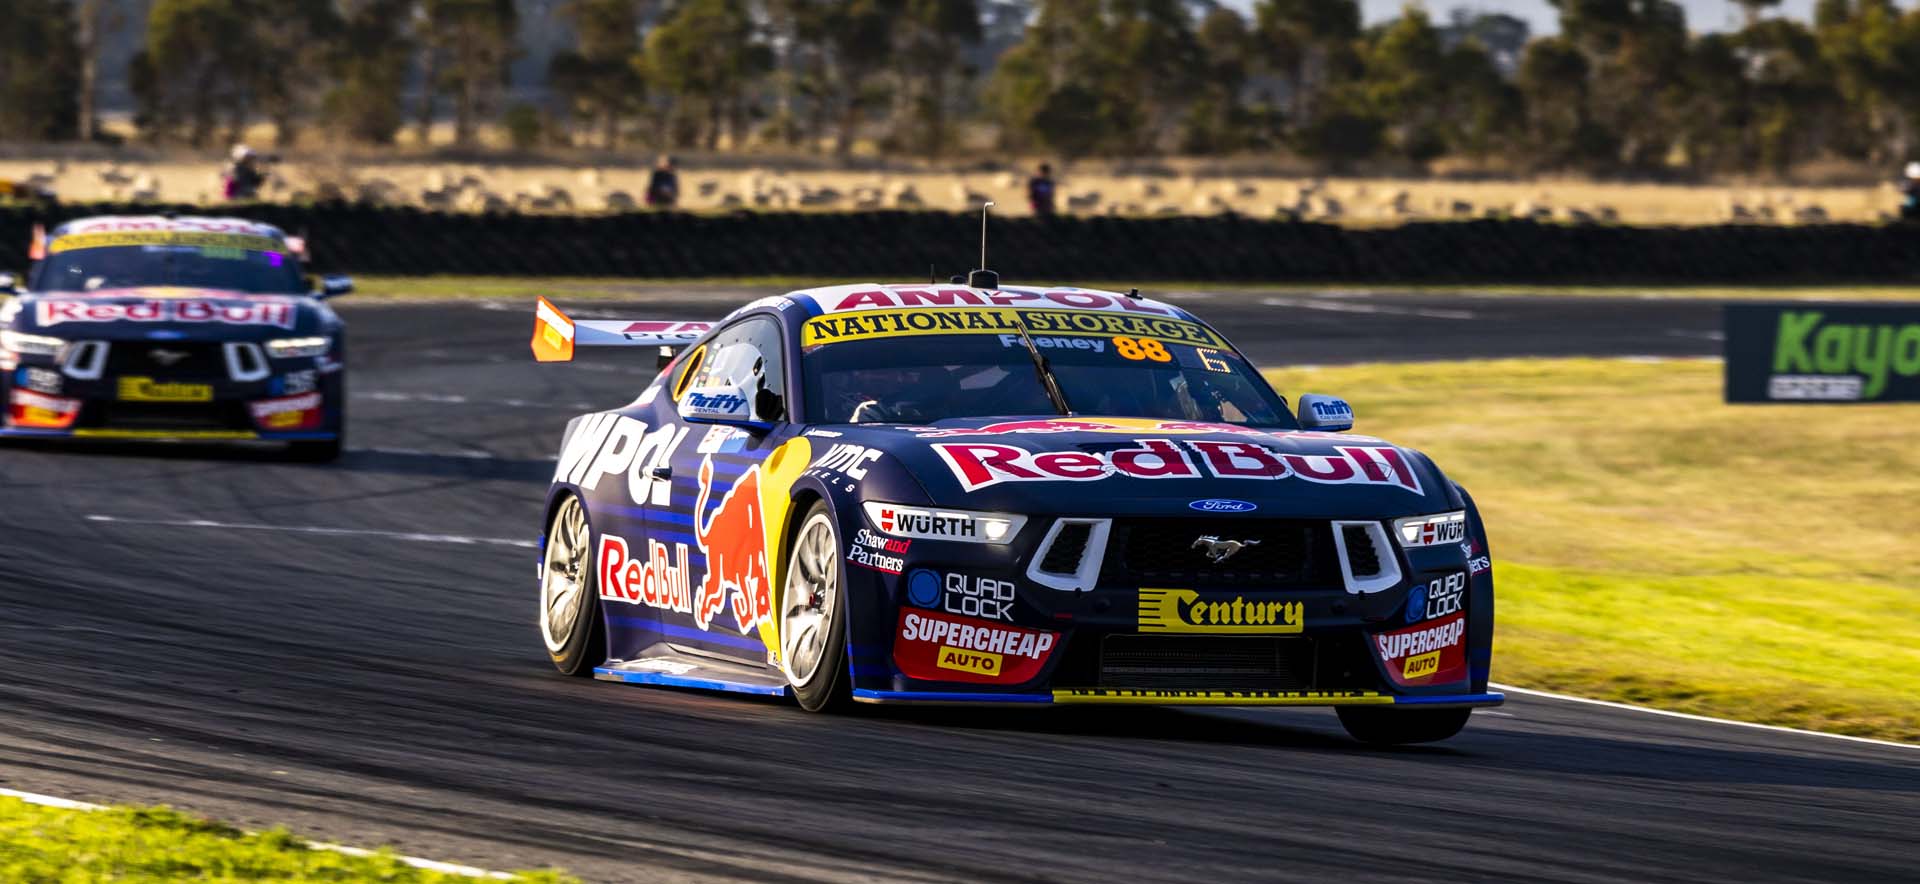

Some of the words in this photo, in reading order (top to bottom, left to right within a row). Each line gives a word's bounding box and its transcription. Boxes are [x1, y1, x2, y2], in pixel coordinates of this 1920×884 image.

[47, 300, 161, 322] Red
[176, 301, 290, 324] Bull
[833, 289, 1169, 315] AMPOL
[809, 312, 1019, 340] NATIONAL
[1026, 312, 1209, 343] STORAGE
[997, 334, 1105, 353] Feeney
[1113, 336, 1172, 362] 88
[1197, 347, 1231, 373] 6
[1774, 311, 1920, 399] Kayo
[689, 392, 747, 413] Thrifty
[935, 441, 1197, 490] Red
[1192, 441, 1421, 493] Bull
[896, 513, 976, 537] WÜRTH
[846, 544, 904, 572] Partners
[945, 572, 1016, 601] QUAD
[1428, 571, 1465, 600] QUAD
[944, 592, 1015, 622] LOCK
[1138, 588, 1304, 633] Century
[1426, 591, 1464, 620] LOCK
[902, 613, 1054, 660] SUPERCHEAP
[1378, 617, 1465, 662] SUPERCHEAP
[943, 652, 995, 670] AUTO
[1406, 656, 1436, 674] AUTO
